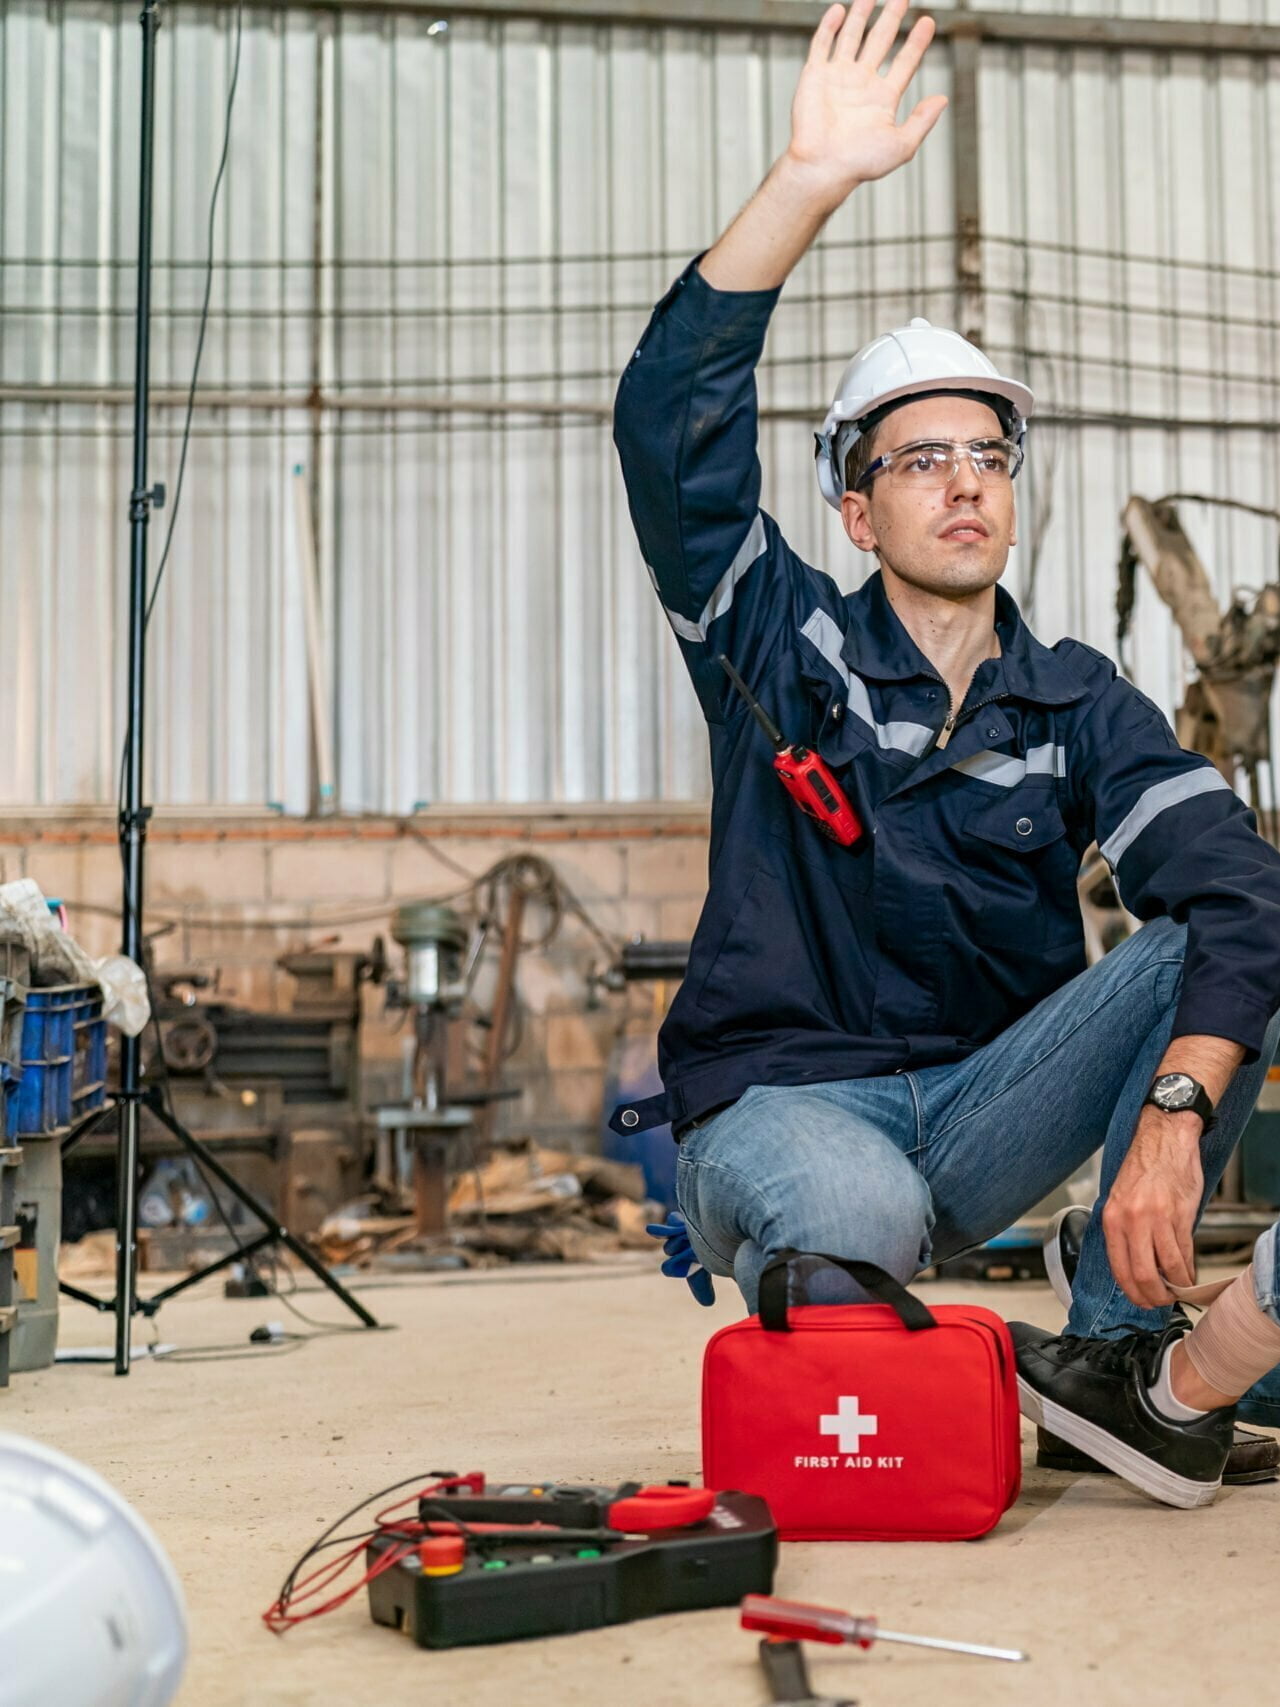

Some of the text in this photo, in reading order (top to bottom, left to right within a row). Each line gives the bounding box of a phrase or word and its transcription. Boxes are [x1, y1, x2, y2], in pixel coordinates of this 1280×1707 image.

[794, 1456, 905, 1468] FIRST AID KIT
